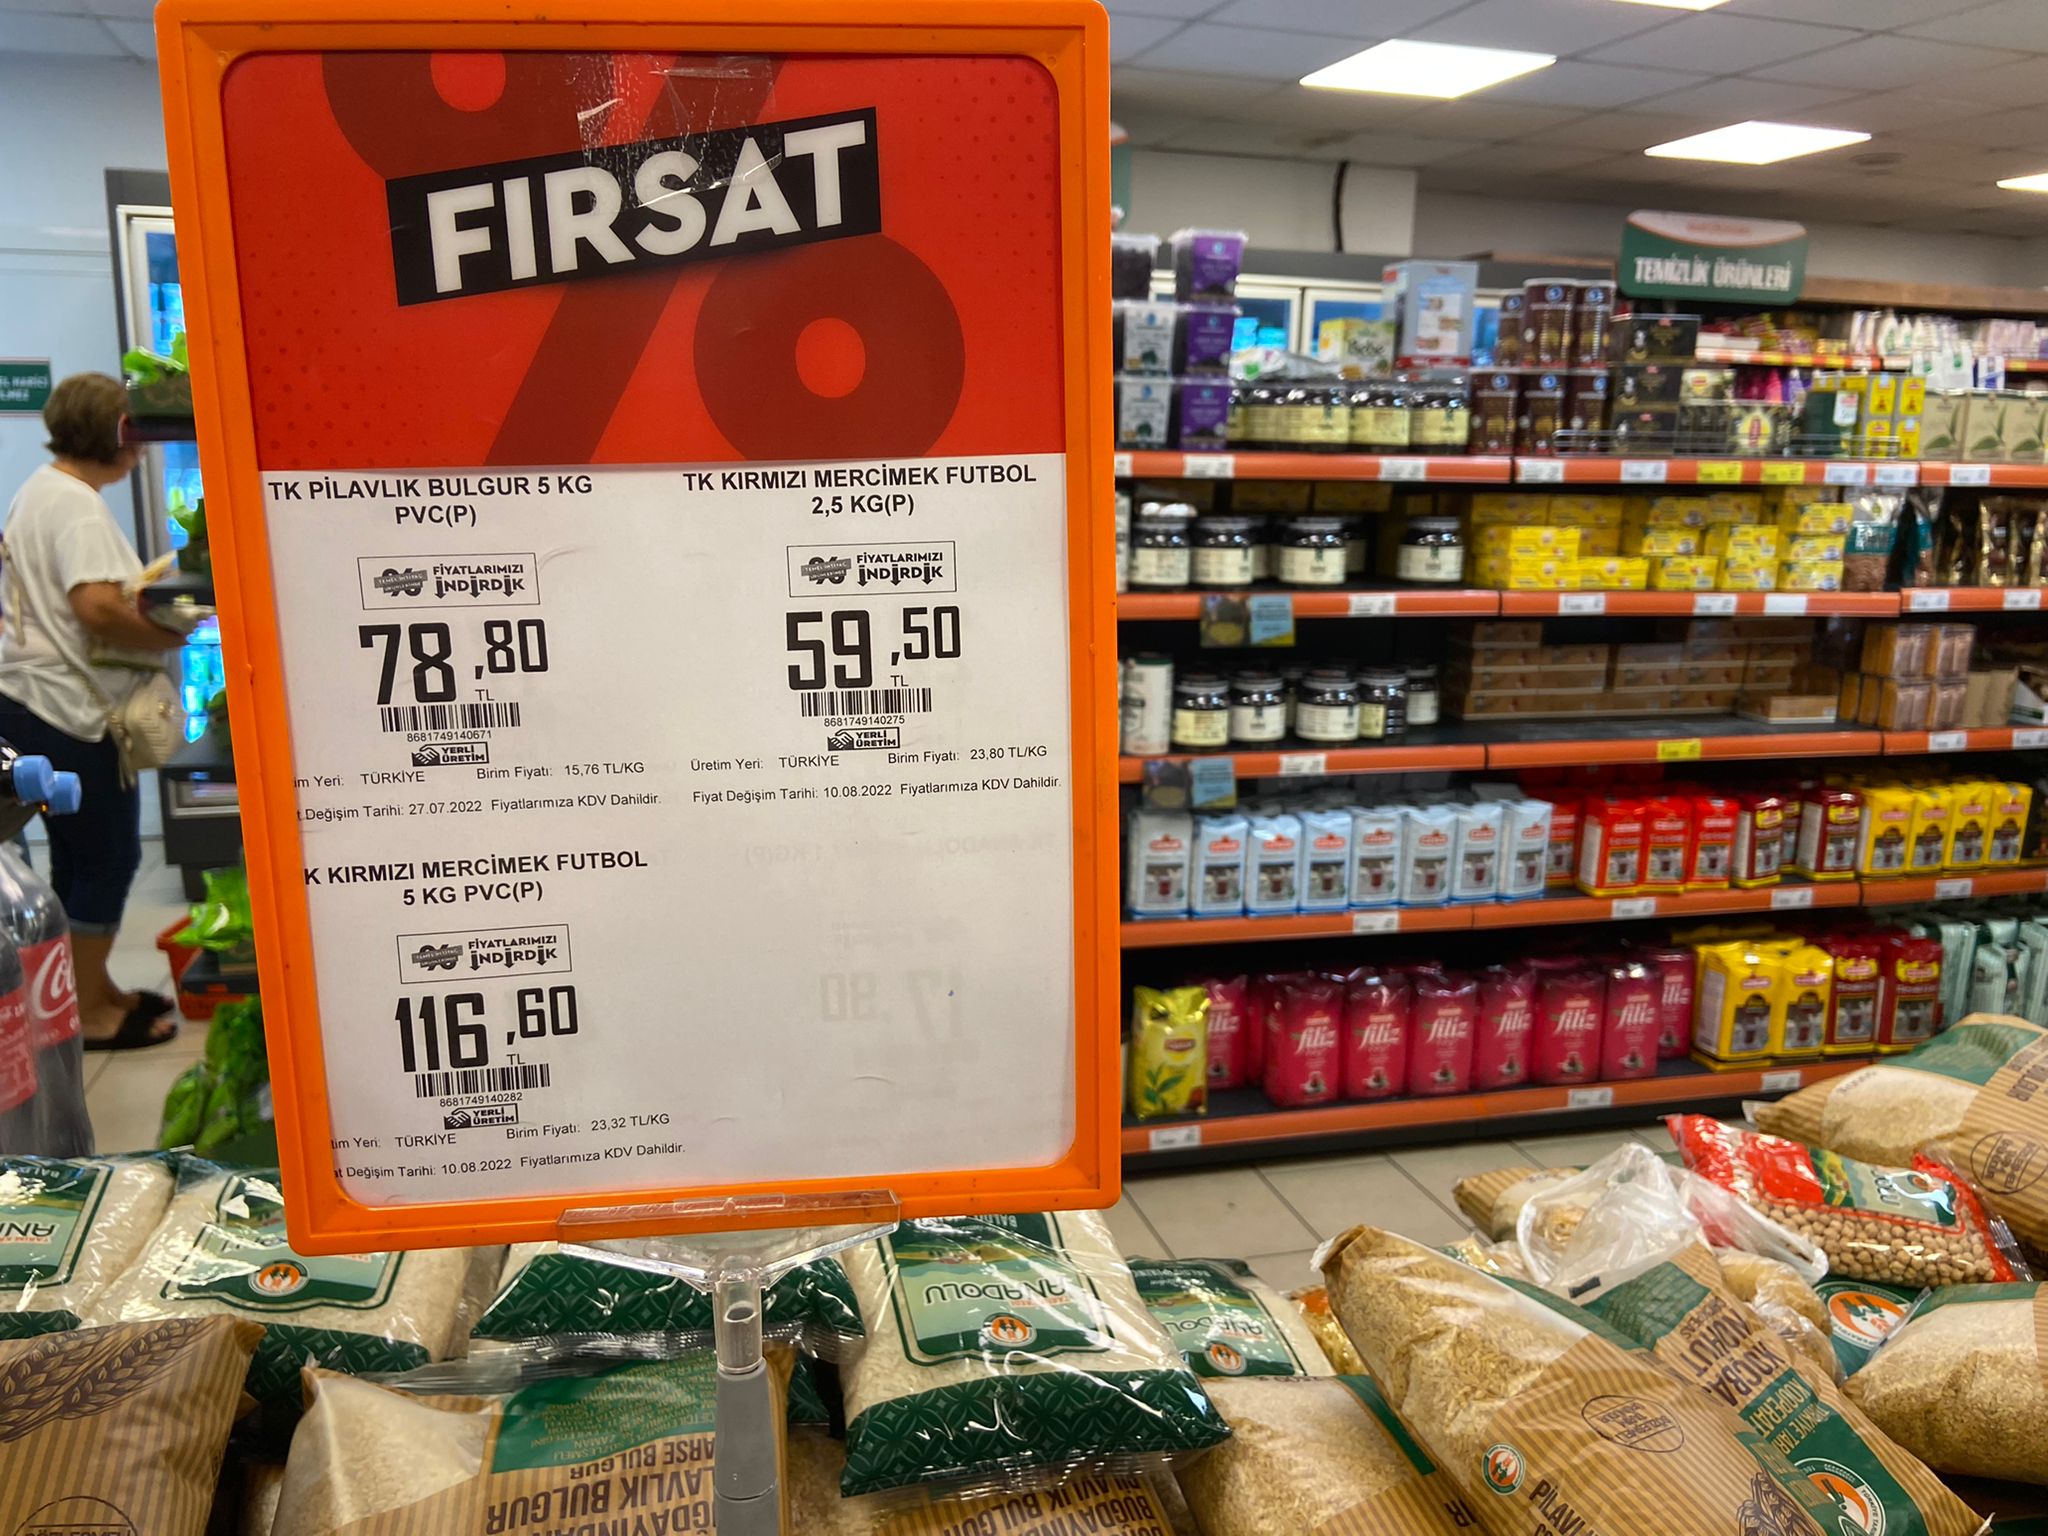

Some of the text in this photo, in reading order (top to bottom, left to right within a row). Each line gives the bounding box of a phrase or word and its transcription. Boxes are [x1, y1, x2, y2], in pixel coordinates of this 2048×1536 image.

[426, 120, 866, 294] FIRSAT
[1634, 253, 1792, 292] TEMİZLİK ÜRÜNLERİ
[269, 475, 592, 500] TK PİLAVLIK BULGUR 5 KG
[683, 463, 1037, 491] TK KIRMIZI MERCİMEK FUTBOL
[395, 505, 477, 527] PVC(P)
[811, 494, 915, 516] 2,5 KG(P)
[857, 551, 944, 563] FİYATLARIMIZI
[433, 563, 525, 576] FİYATLARIMIZI
[890, 674, 909, 687] TL
[475, 688, 494, 702] TL
[823, 715, 905, 727] 8681749140275
[406, 730, 492, 741] 8681749140671
[855, 730, 887, 738] YERLİ
[855, 738, 896, 748] ÜRETİM
[441, 753, 485, 762] ÜRETİM
[442, 745, 474, 753] YERLİ
[691, 745, 1047, 771] Üretim Yeri: TÜRKİYE Birim Fiyatı: 23,80 TL/KG
[313, 774, 344, 787] Yeri:
[360, 770, 425, 785] TÜRKİYE
[476, 766, 510, 780] Birim
[515, 765, 553, 778] Fiyatı:
[564, 764, 599, 777] 15,76
[603, 762, 645, 775] TL/KG
[692, 775, 1061, 804] Fiyat Değişim Tarihi: 10.08.2022 Fiyatlarımıza KDV Dahildir.
[305, 807, 359, 822] Değişim
[363, 804, 405, 818] Tarihi:
[409, 800, 482, 815] 27.07.2022
[491, 796, 574, 812] Fiyatlarımıza
[577, 794, 607, 807] KDV
[610, 792, 661, 807] Dahildir.
[327, 862, 415, 884] KIRMIZI
[422, 853, 549, 879] MERCİMEK
[556, 850, 648, 871] FUTBOL
[403, 880, 544, 906] 5 KG PVC(P)
[469, 934, 557, 949] FİYATLARIMIZI
[506, 1053, 525, 1066] TL
[439, 1092, 523, 1107] 8681749140282
[473, 1107, 505, 1116] YERLİ
[473, 1115, 515, 1125] ÜRETİM
[353, 1136, 380, 1149] Yeri:
[395, 1131, 456, 1148] TÜRKİYE
[506, 1125, 539, 1140] Birim
[542, 1122, 580, 1138] Fiyatı:
[590, 1116, 626, 1132] 23,32
[630, 1113, 670, 1128] TL/KG
[346, 1164, 395, 1179] Değişim
[398, 1164, 436, 1178] Tarihi:
[441, 1158, 512, 1175] 10.08.2022
[519, 1150, 601, 1169] Fiyatlarımıza
[603, 1146, 634, 1160] KDV
[636, 1142, 685, 1157] Dahildir.
[1679, 1308, 1753, 1378] NOHUT
[569, 1443, 658, 1480] BULGUR
[486, 1479, 611, 1535] BULGUR
